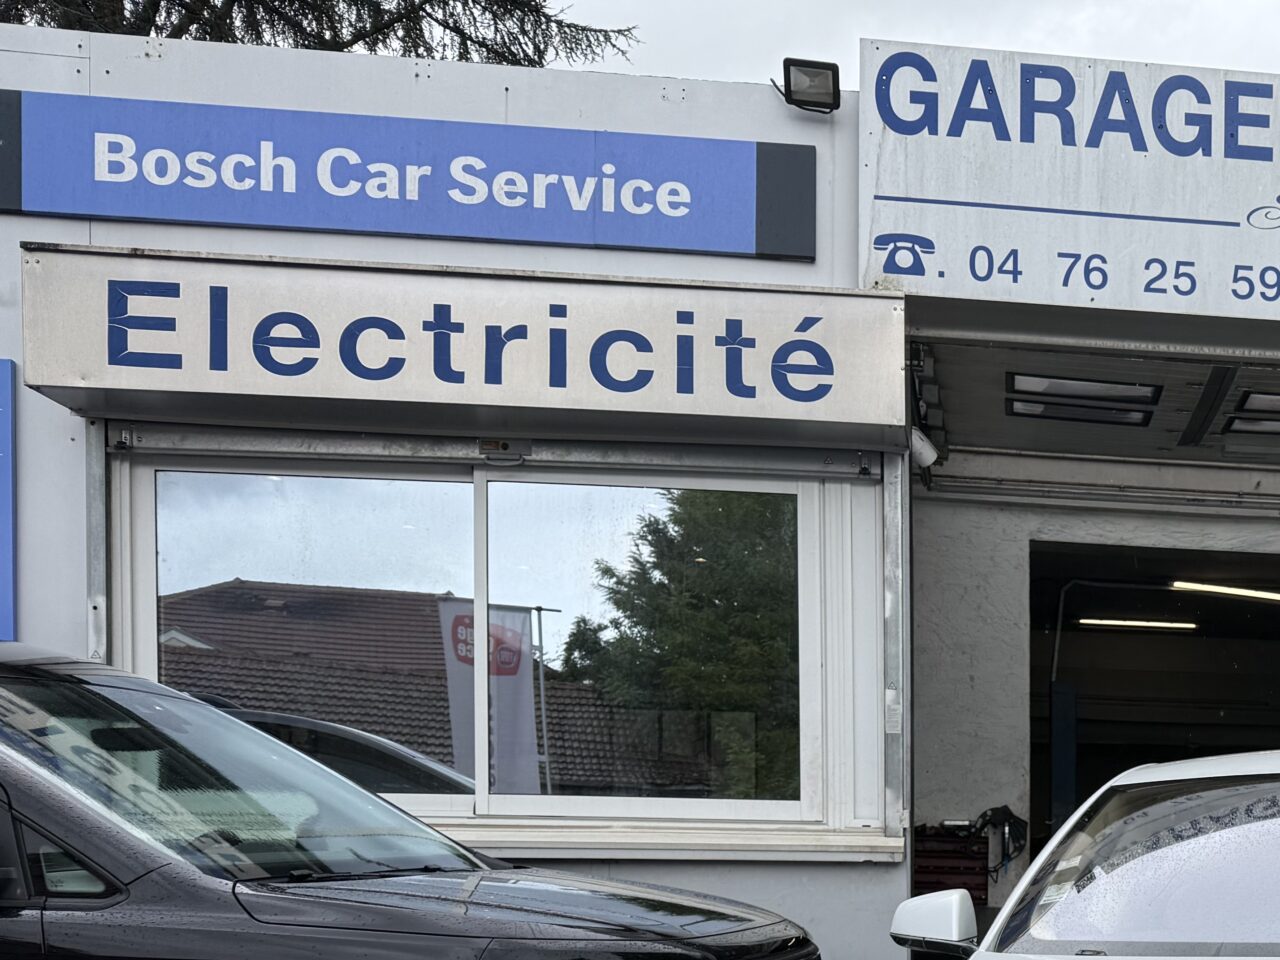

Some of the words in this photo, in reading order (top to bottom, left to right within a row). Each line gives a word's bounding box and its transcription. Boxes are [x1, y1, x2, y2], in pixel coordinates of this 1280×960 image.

[875, 52, 1273, 161] GARAGE
[94, 132, 296, 193] Bosch
[316, 147, 432, 201] Car
[447, 156, 691, 217] Service
[969, 246, 1023, 284] 04
[1057, 253, 1109, 291] 76
[1143, 259, 1197, 297] 25
[107, 280, 835, 403] Electricité
